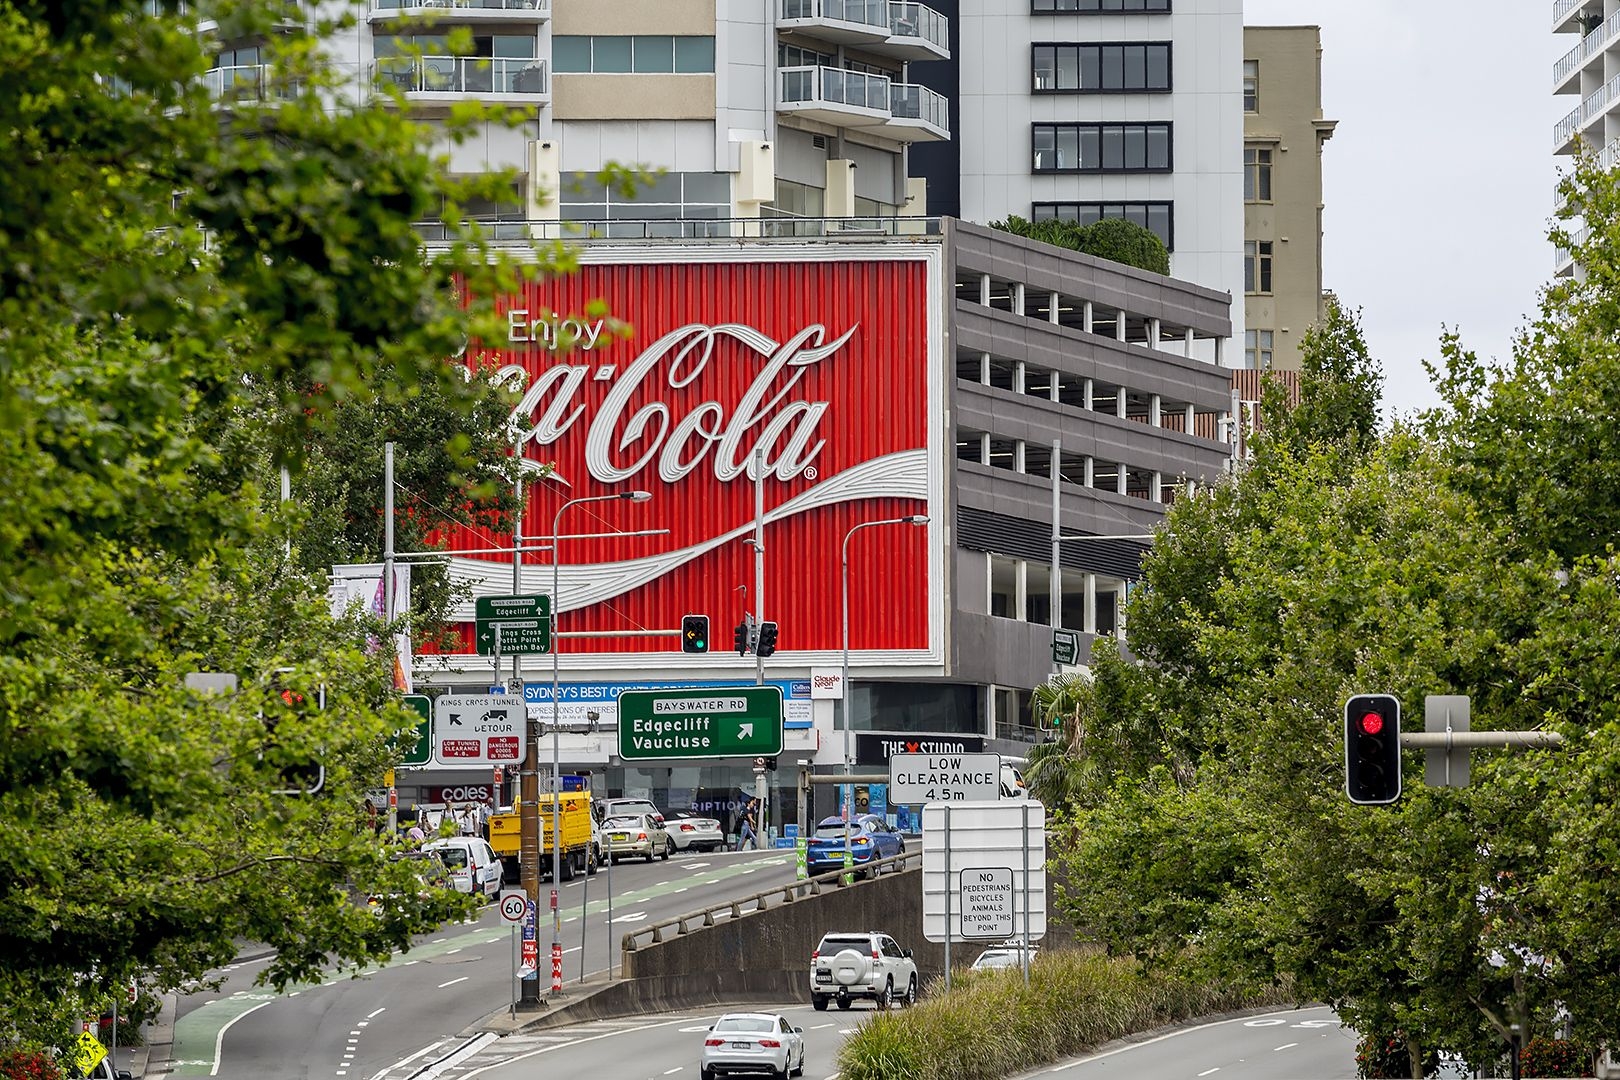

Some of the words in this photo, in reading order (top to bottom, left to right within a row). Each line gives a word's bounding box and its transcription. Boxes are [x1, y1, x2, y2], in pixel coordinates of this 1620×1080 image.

[508, 309, 604, 350] Enjoy
[496, 608, 529, 616] Edgecliff
[530, 643, 545, 651] Bay
[580, 686, 608, 698] BEST
[655, 700, 724, 711] BAYSWATER
[730, 700, 745, 709] RD
[474, 724, 513, 733] DETOUR
[633, 717, 710, 736] Edgecliff
[632, 735, 711, 749] Vaucluse
[881, 740, 905, 758] THE
[929, 758, 961, 770] LOW
[897, 773, 993, 785] CLEARANCE
[441, 786, 489, 801] coles
[925, 788, 965, 801] 4.5m
[979, 873, 994, 882] NO
[963, 884, 1011, 892] PEDESTRIANS
[969, 894, 1004, 902] BICYCLES
[505, 902, 523, 914] 60
[971, 904, 1003, 912] ANIMALS
[963, 914, 992, 922] BEYOND
[977, 924, 998, 932] POINT
